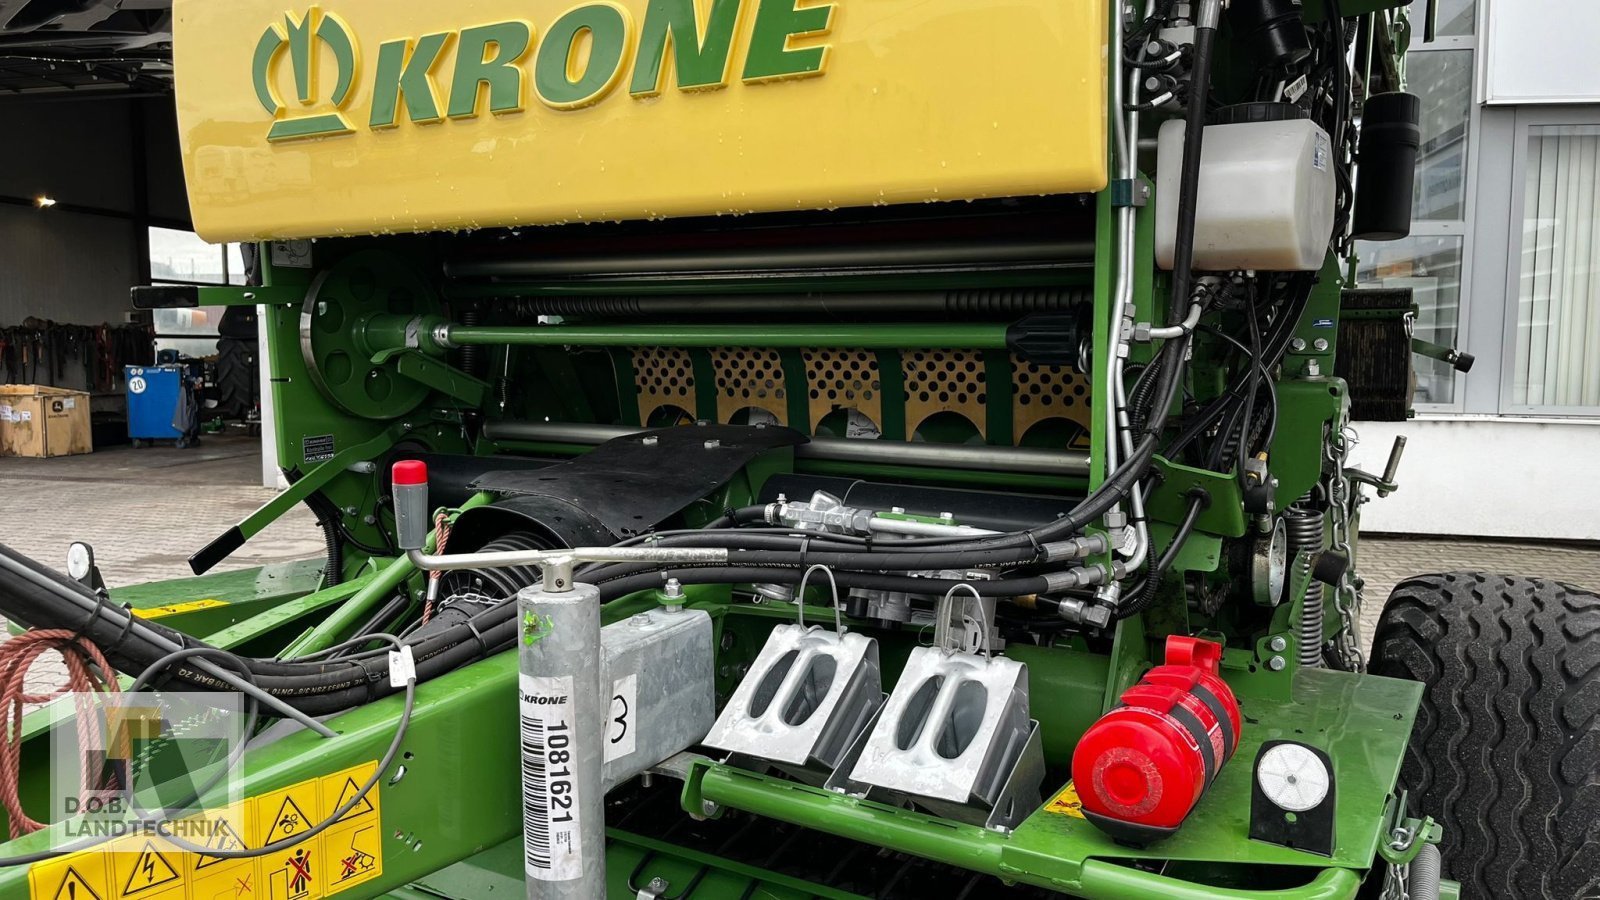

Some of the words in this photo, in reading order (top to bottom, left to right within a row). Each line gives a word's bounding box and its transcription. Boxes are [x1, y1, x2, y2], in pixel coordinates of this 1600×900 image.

[369, 0, 838, 130] KRONE
[132, 380, 143, 390] 20
[194, 673, 215, 685] BAR
[524, 695, 568, 705] KRONE
[547, 720, 573, 823] 1081621
